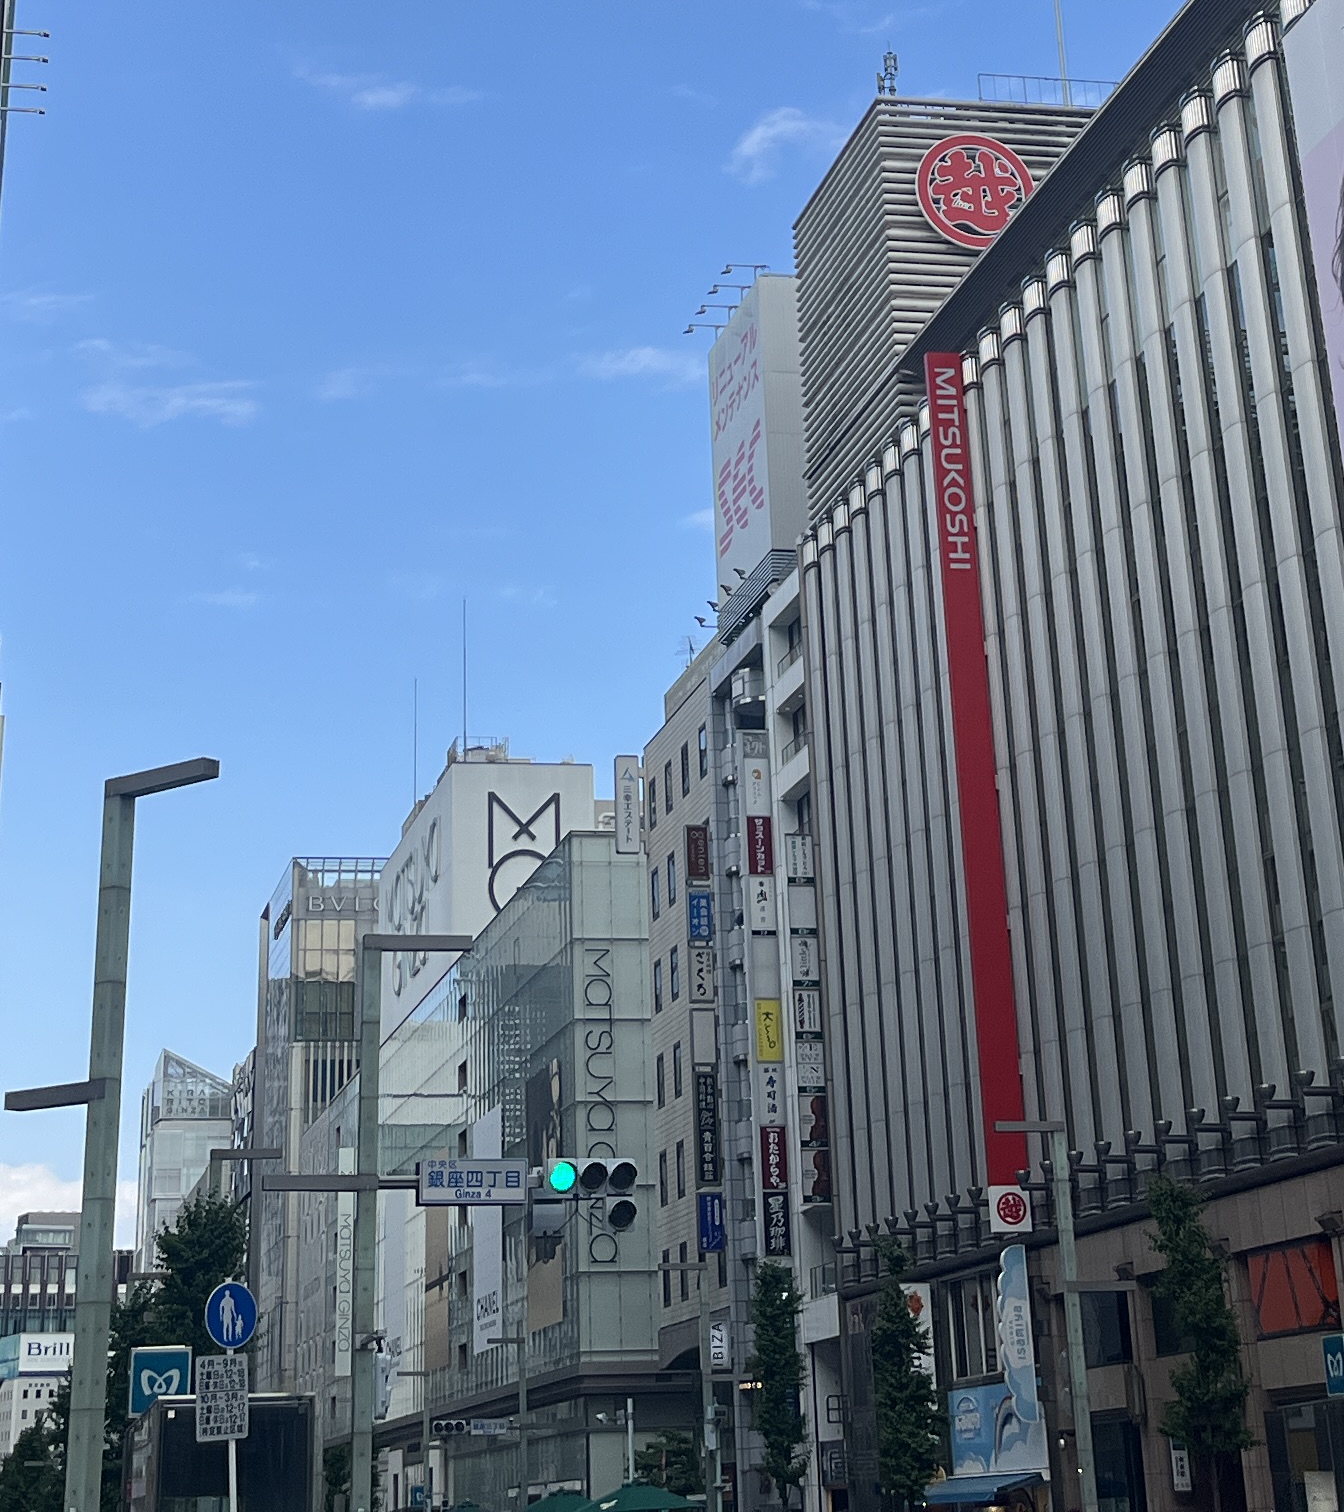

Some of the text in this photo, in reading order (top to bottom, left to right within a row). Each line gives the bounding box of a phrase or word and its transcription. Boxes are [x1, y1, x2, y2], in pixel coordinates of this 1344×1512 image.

[712, 323, 757, 407] リニューアル
[715, 358, 760, 442] メンテナンス
[934, 367, 971, 569] MITSUKOSHI
[695, 951, 707, 997] ざくろ
[427, 1160, 457, 1169] 中央区
[427, 1170, 520, 1188] 銀座四丁目
[767, 1132, 781, 1188] おたからや
[455, 1189, 492, 1199] Ginza 4
[27, 1342, 70, 1356] Brill
[711, 1322, 724, 1367] IBIZA
